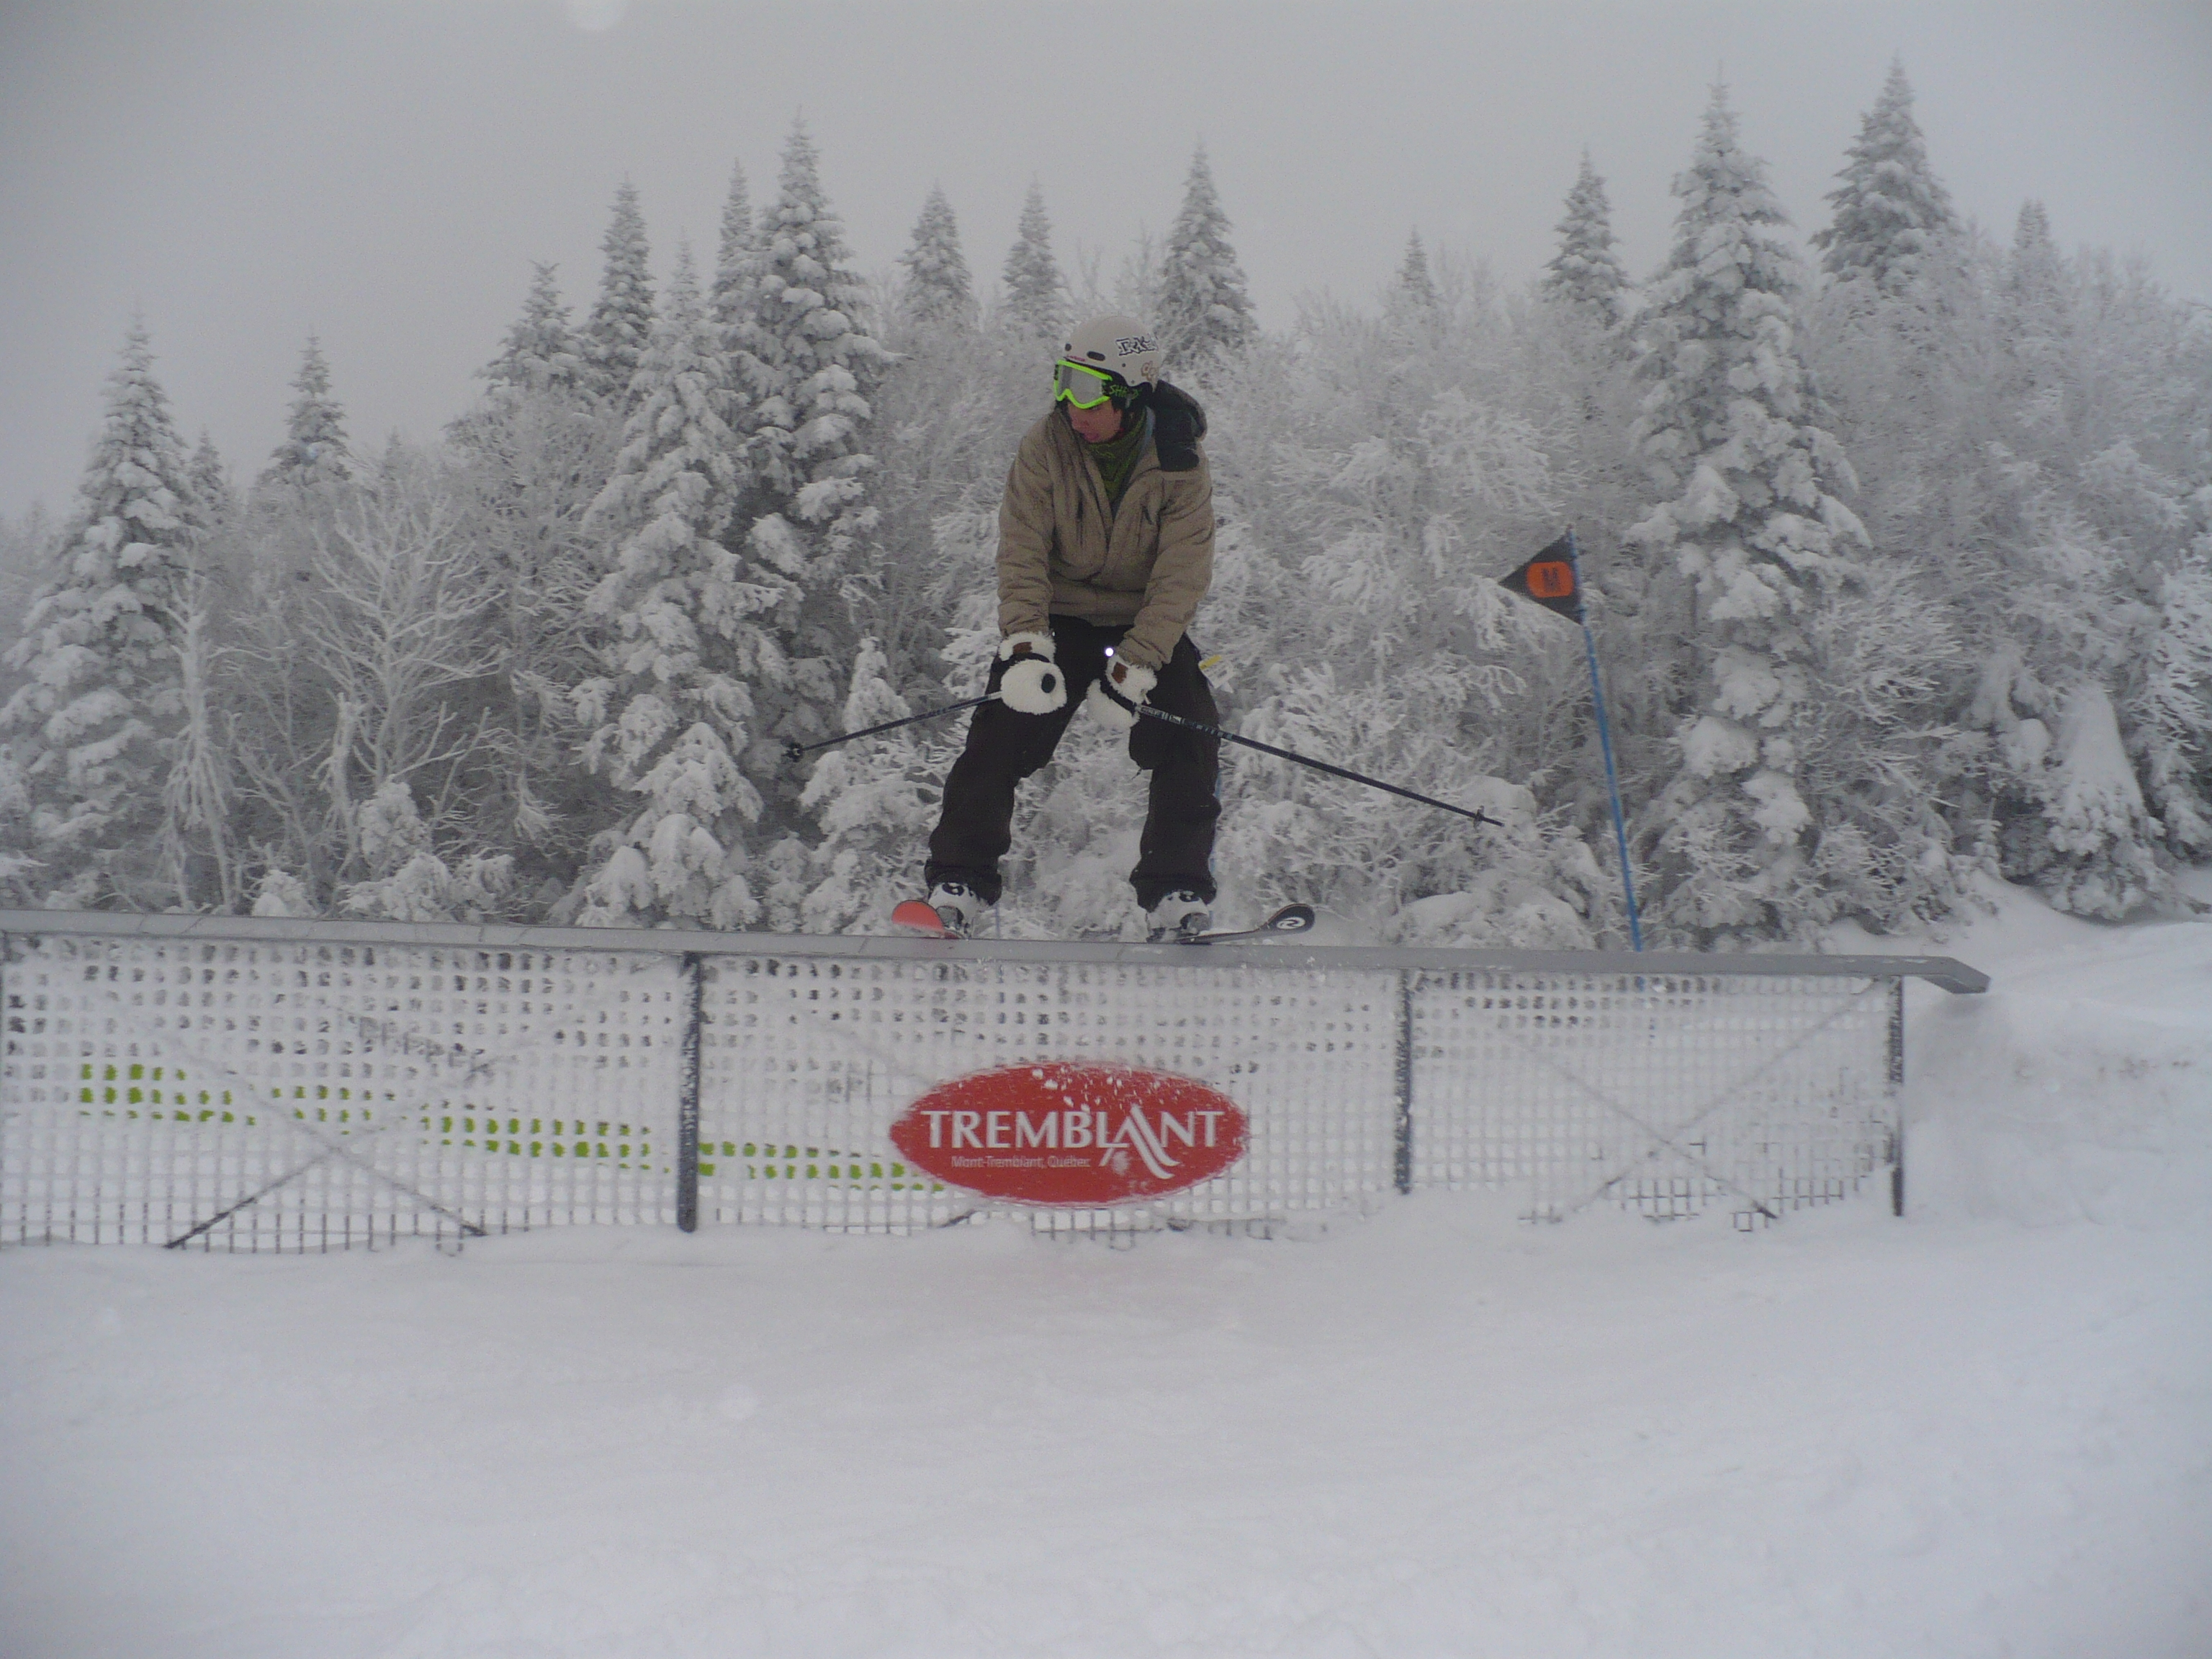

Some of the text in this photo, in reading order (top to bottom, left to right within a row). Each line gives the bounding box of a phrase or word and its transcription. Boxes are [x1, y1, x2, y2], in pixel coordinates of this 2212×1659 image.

[920, 1104, 1224, 1179] TREMBLANT
[950, 1155, 1091, 1168] Mont-Tremblant, Québec
